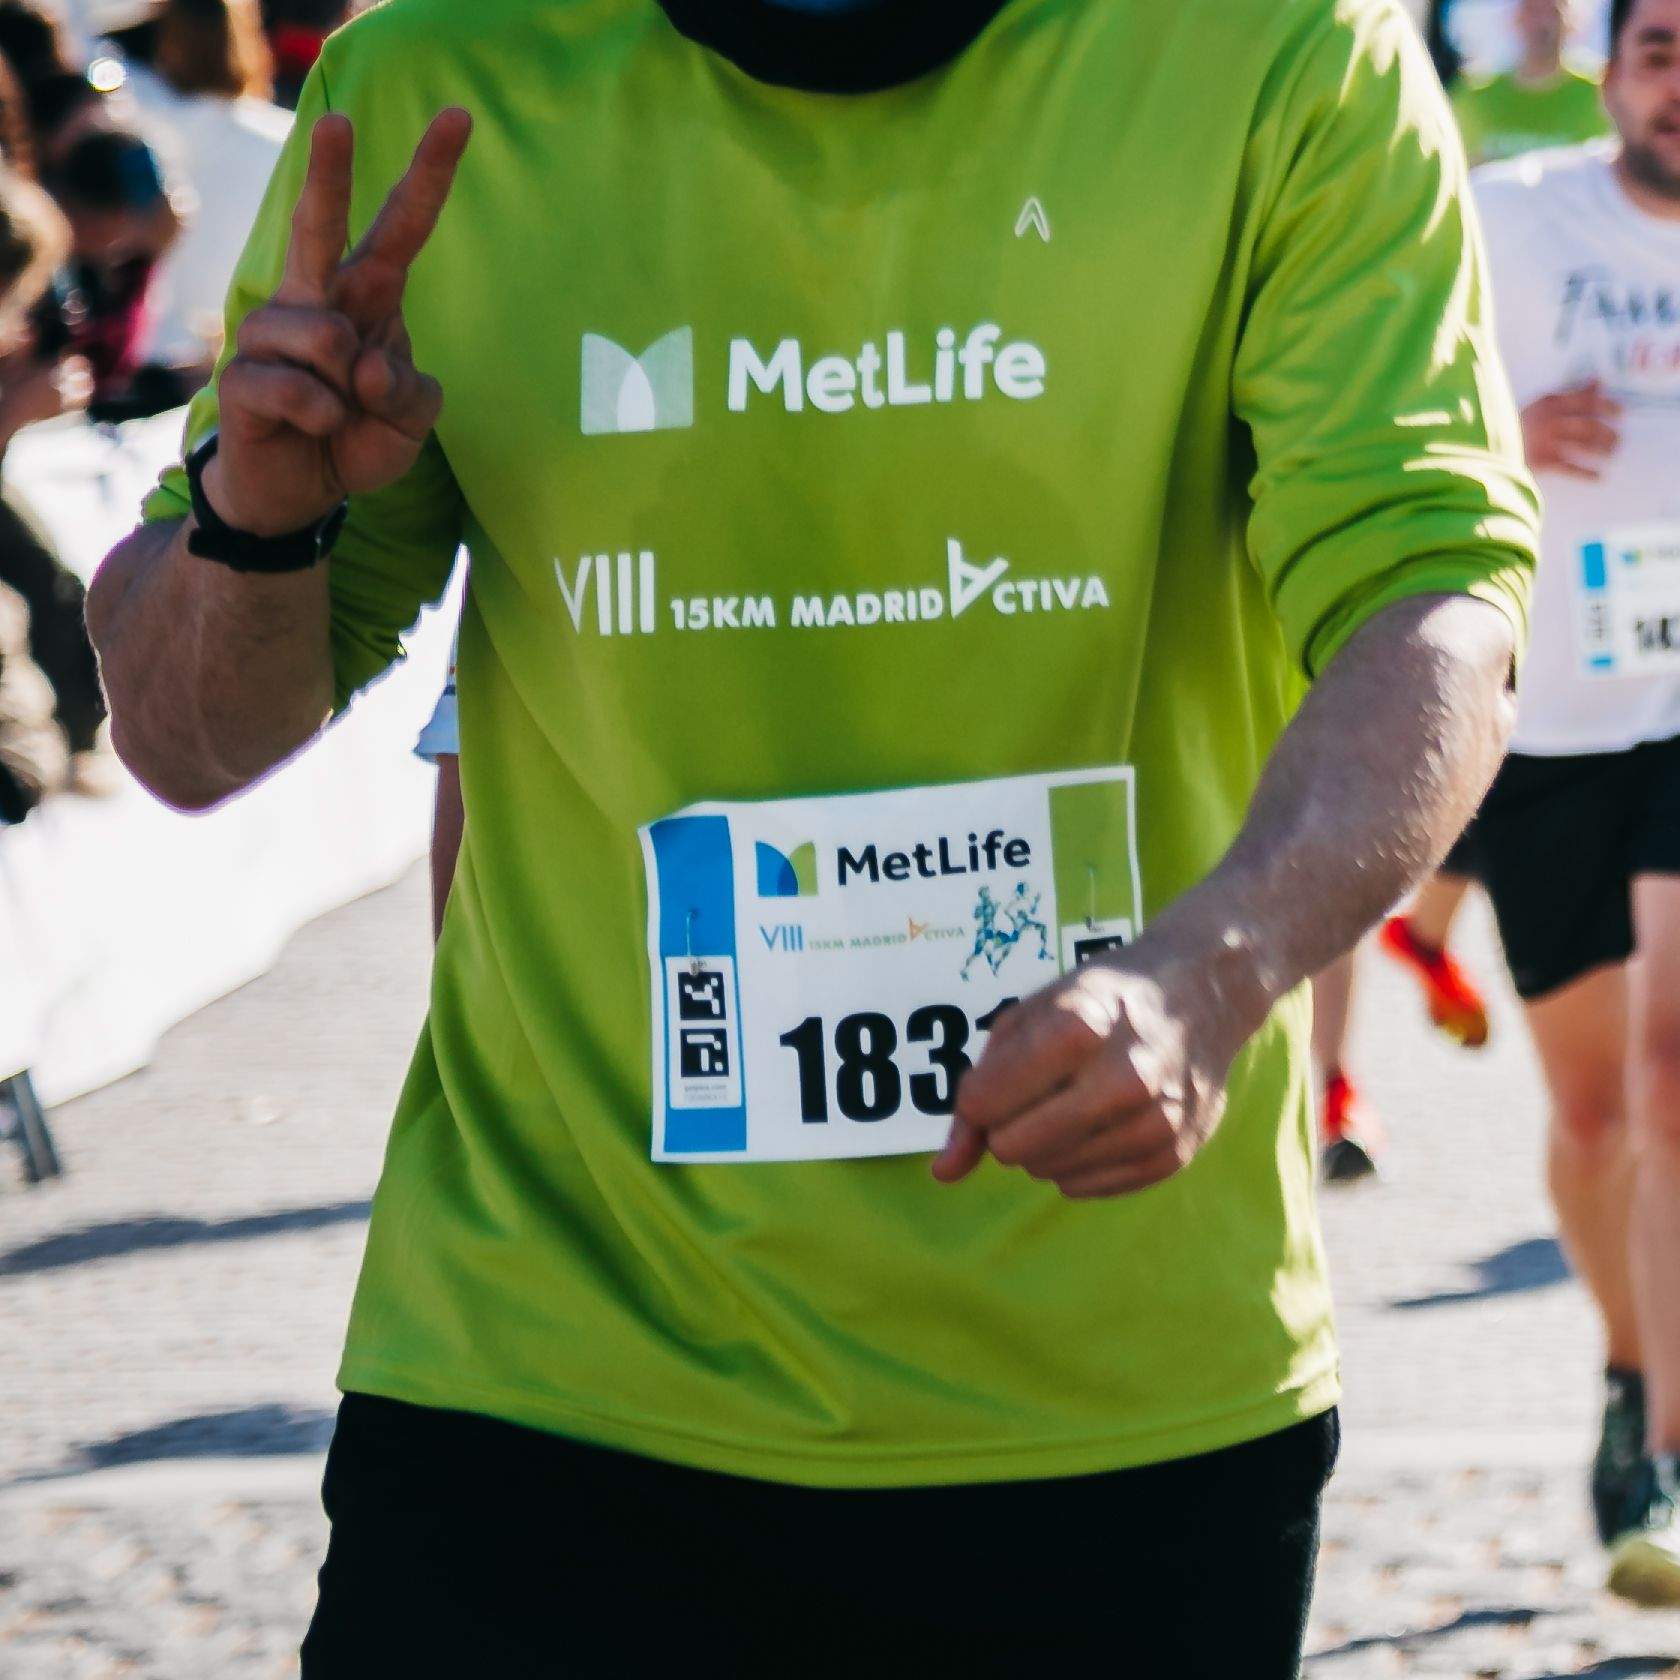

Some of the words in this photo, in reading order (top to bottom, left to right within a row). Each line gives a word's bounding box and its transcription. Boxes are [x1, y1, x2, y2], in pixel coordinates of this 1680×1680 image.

[727, 321, 1046, 413] MetLife
[554, 551, 655, 636] VIII
[671, 595, 775, 631] 15KM
[837, 829, 1031, 885] MetLife
[759, 924, 804, 952] VIII
[780, 996, 1018, 1126] 183
